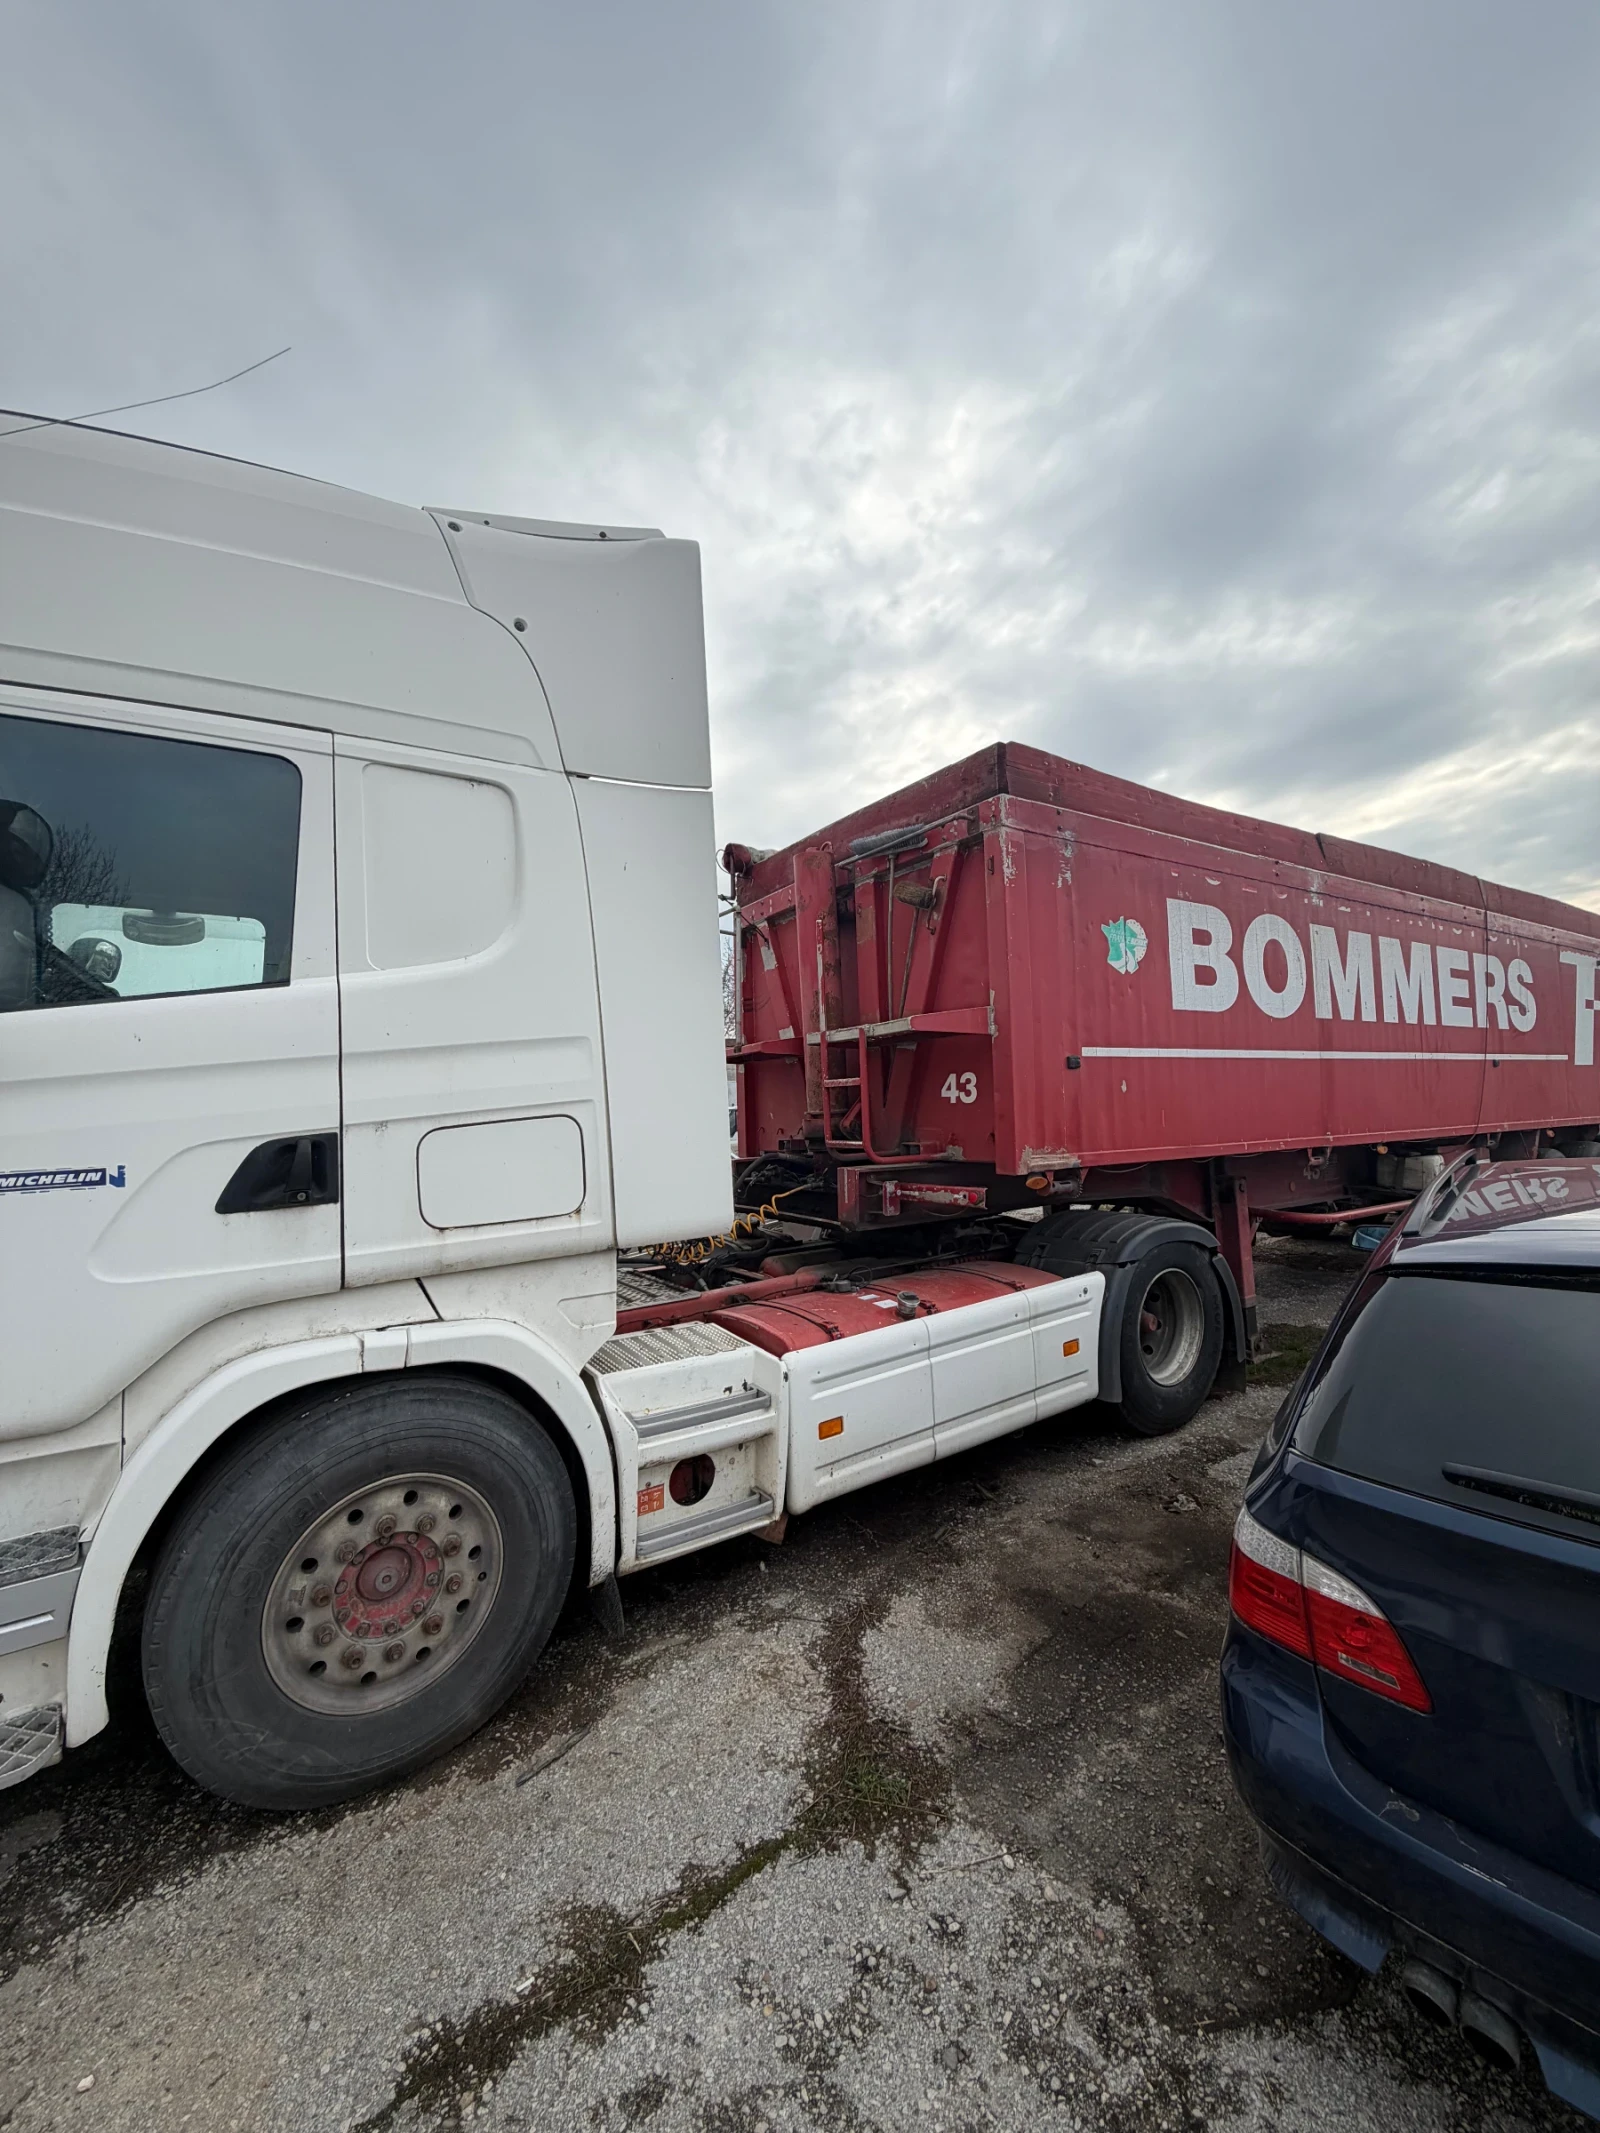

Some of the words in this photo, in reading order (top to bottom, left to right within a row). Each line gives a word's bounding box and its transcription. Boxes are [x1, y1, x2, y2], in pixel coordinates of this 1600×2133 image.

[1166, 897, 1537, 1032] BOMMERS
[941, 1071, 978, 1104] 43
[0, 1172, 102, 1188] MICHELIN
